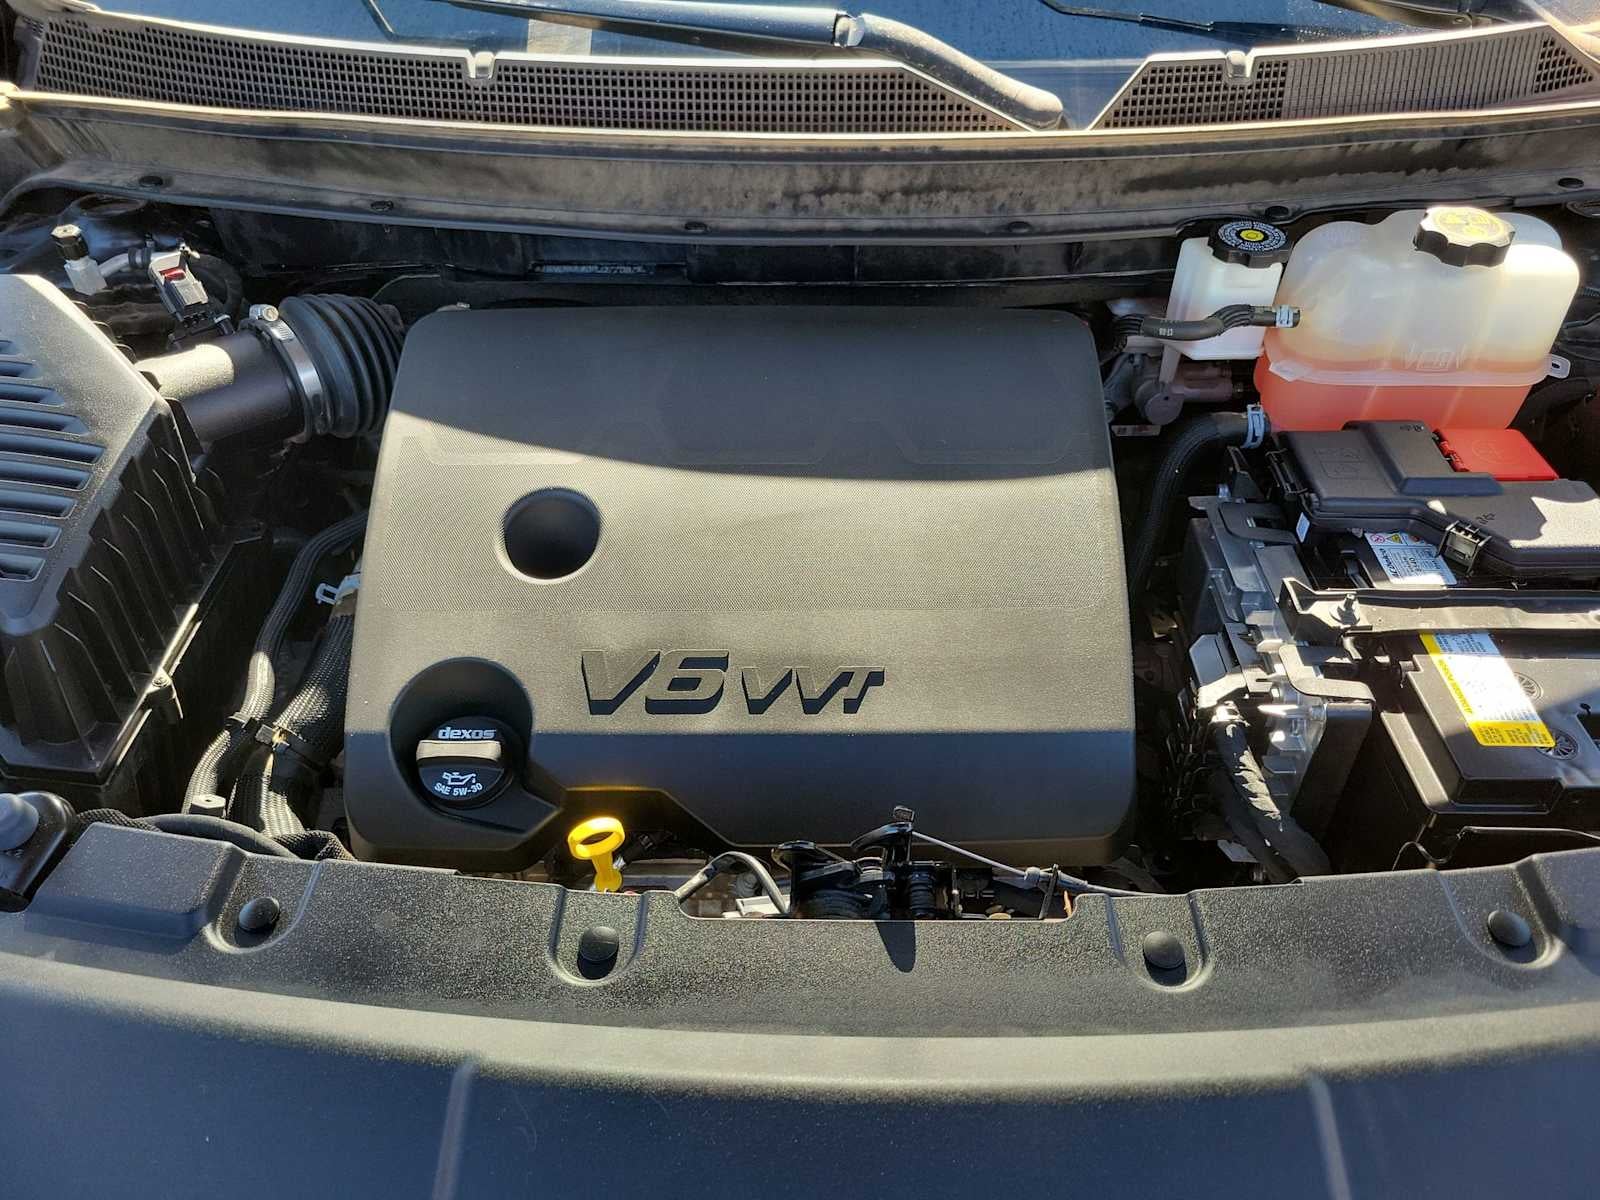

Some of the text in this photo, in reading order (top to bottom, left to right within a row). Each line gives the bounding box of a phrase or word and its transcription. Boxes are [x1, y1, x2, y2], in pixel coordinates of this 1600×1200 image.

[581, 649, 885, 715] V6 VVT
[438, 727, 497, 739] dexos
[434, 783, 483, 796] SAE 5W-30
